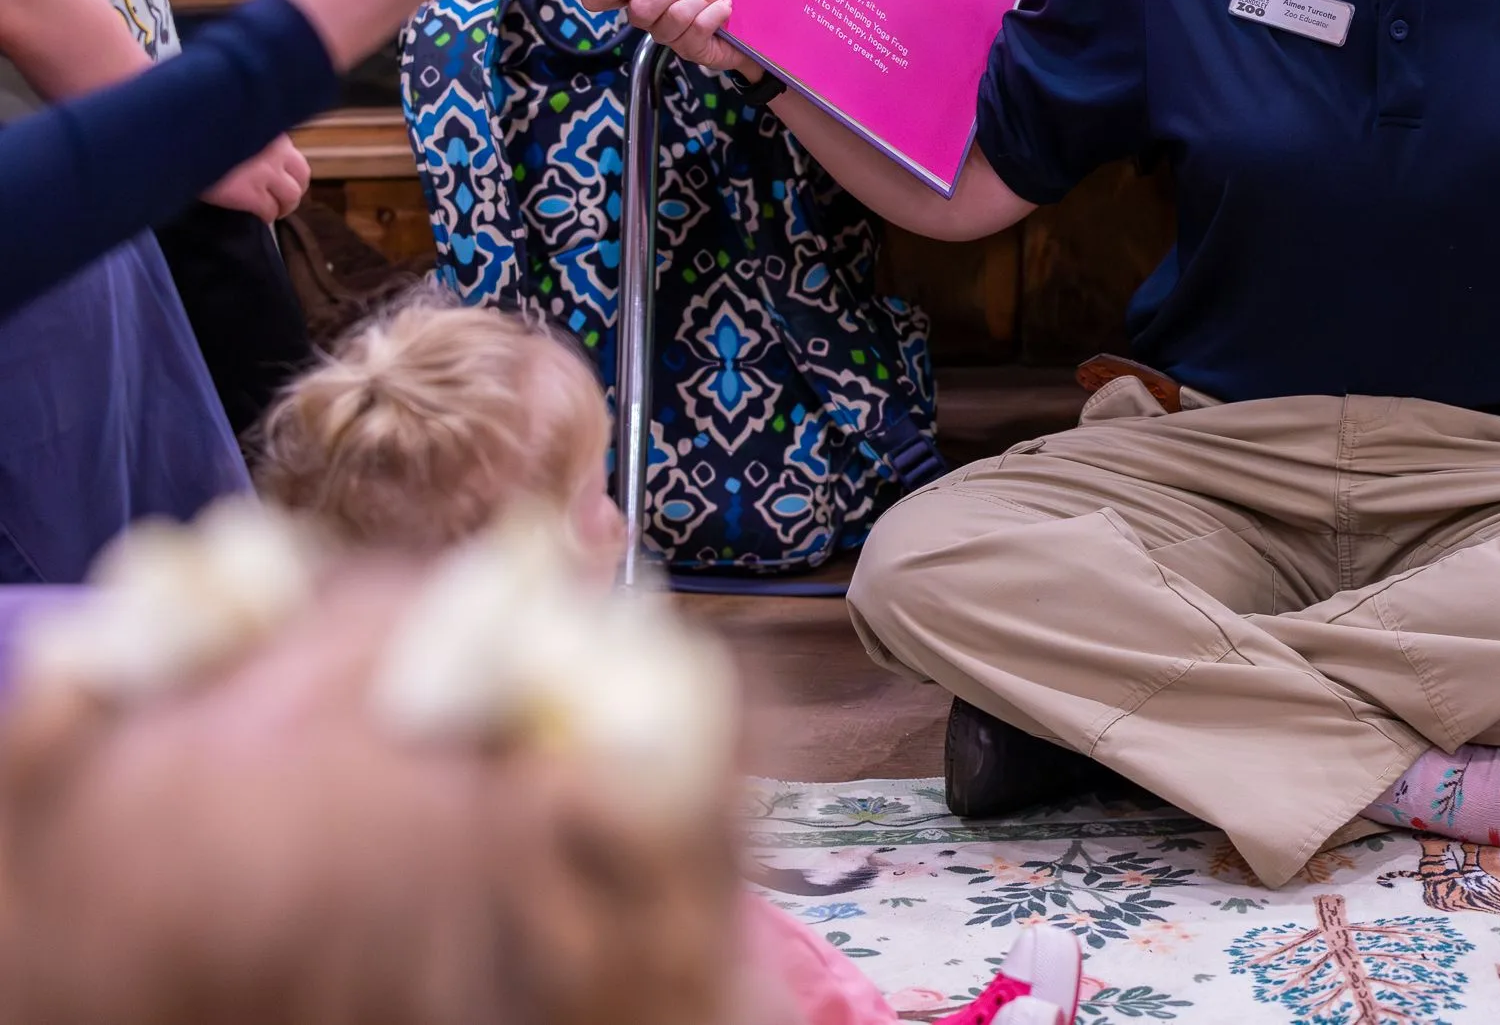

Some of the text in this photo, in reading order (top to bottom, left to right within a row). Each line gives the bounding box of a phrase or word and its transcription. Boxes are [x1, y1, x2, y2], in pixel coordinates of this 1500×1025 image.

[865, 0, 876, 12] sit
[875, 8, 887, 22] up.
[1236, 2, 1265, 17] ZOO
[1283, 0, 1337, 20] Aimee Turcotte
[1284, 10, 1329, 28] Zoo Educator
[821, 0, 831, 11] to
[831, 5, 843, 20] his
[843, 14, 867, 40] happy,
[867, 33, 892, 57] hoppy
[890, 53, 909, 70] self!
[844, 1, 872, 29] helping
[873, 21, 891, 41] Yoga
[890, 36, 909, 57] Frog
[816, 14, 835, 32] time
[835, 27, 848, 41] for
[852, 43, 874, 62] great
[873, 58, 889, 74] day.
